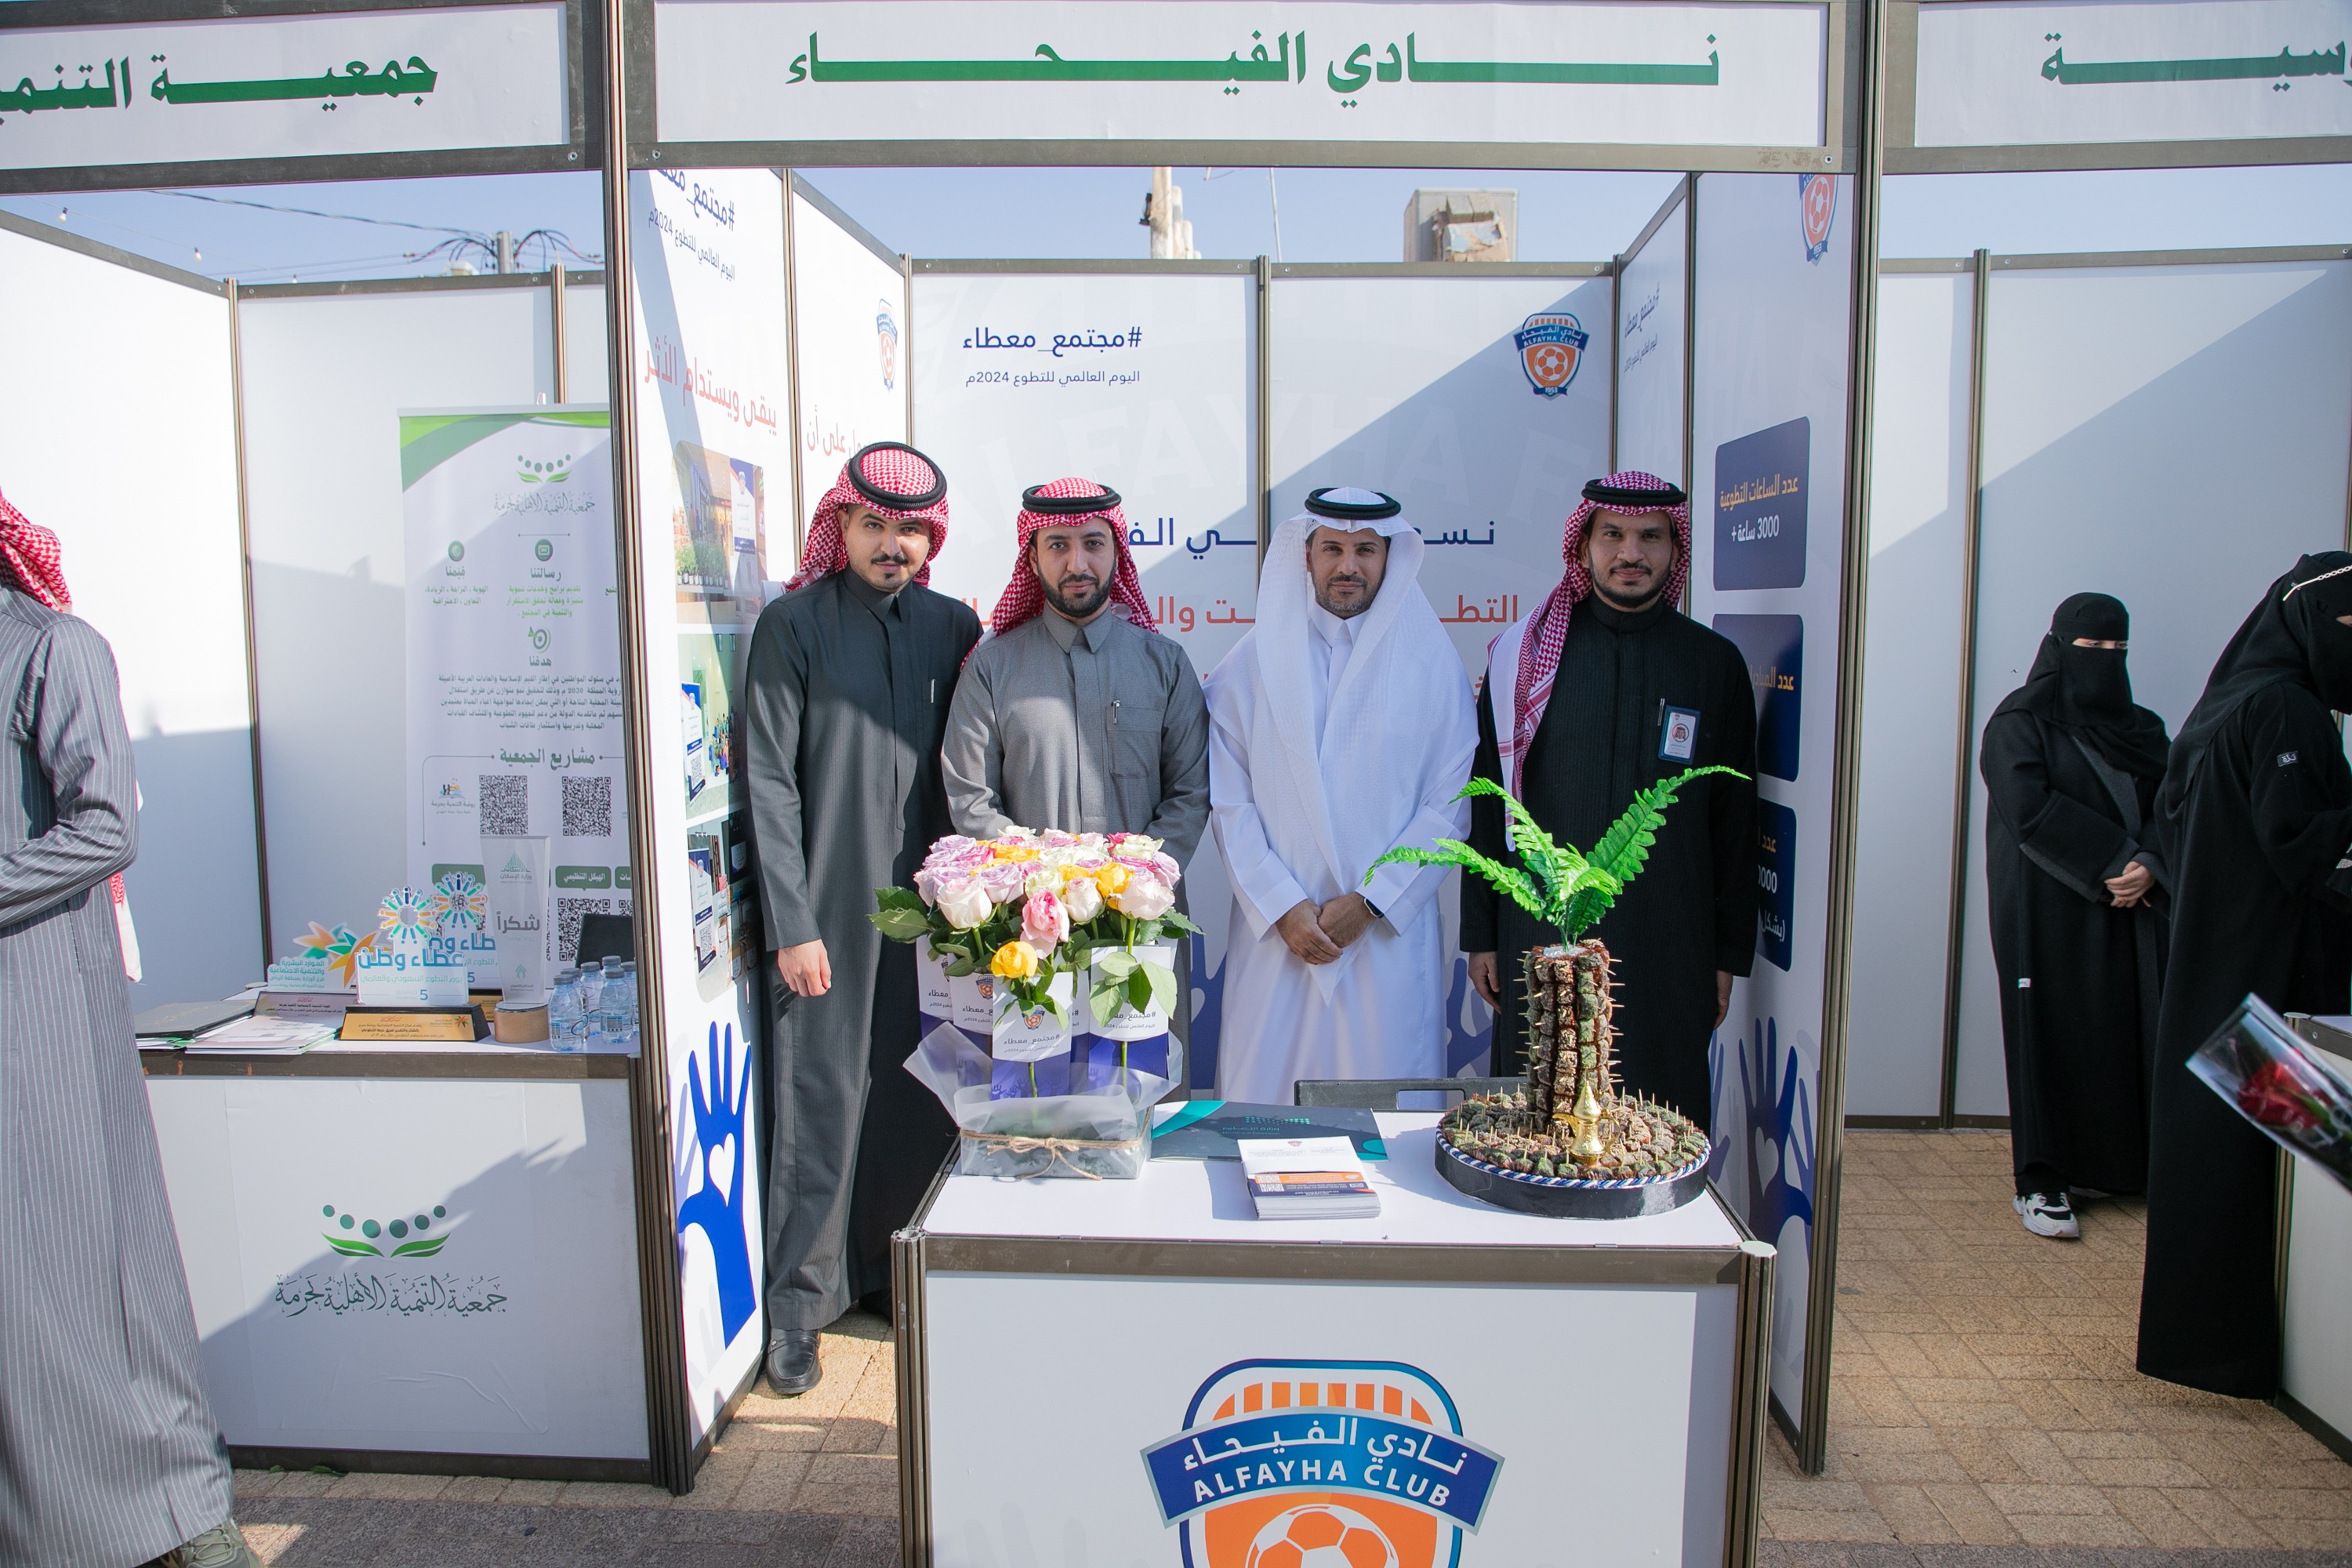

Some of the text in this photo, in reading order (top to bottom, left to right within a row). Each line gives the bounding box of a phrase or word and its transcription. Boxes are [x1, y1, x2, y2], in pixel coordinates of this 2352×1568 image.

[785, 29, 1720, 108] نادي الفيحاء
[2041, 32, 2352, 92] سية
[151, 54, 439, 112] جمعية
[1521, 325, 1582, 340] نادي الفيحاء
[1523, 335, 1579, 347] ALFAYHA CLUB
[644, 335, 777, 437] يبقى ويستدام الأثر
[966, 370, 1141, 388] اليوم العالمي للتطوع 2024م
[1719, 473, 1798, 512] عدد الساعات التطوعية
[1737, 520, 1755, 542] ساعة
[1757, 514, 1780, 539] 3000
[445, 565, 466, 580] قيمنا
[530, 567, 561, 581] رسالتنا
[529, 655, 552, 667] هدفنا
[1777, 675, 1794, 691] عدد
[499, 747, 595, 770] مشاريع الجمعية
[1762, 835, 1777, 853] عدد
[358, 948, 465, 971] عطاء وطن
[419, 989, 429, 1001] 5
[1183, 1416, 1468, 1475] نادي الفيحاء
[1192, 1458, 1451, 1507] ALFAYHA CLUB
